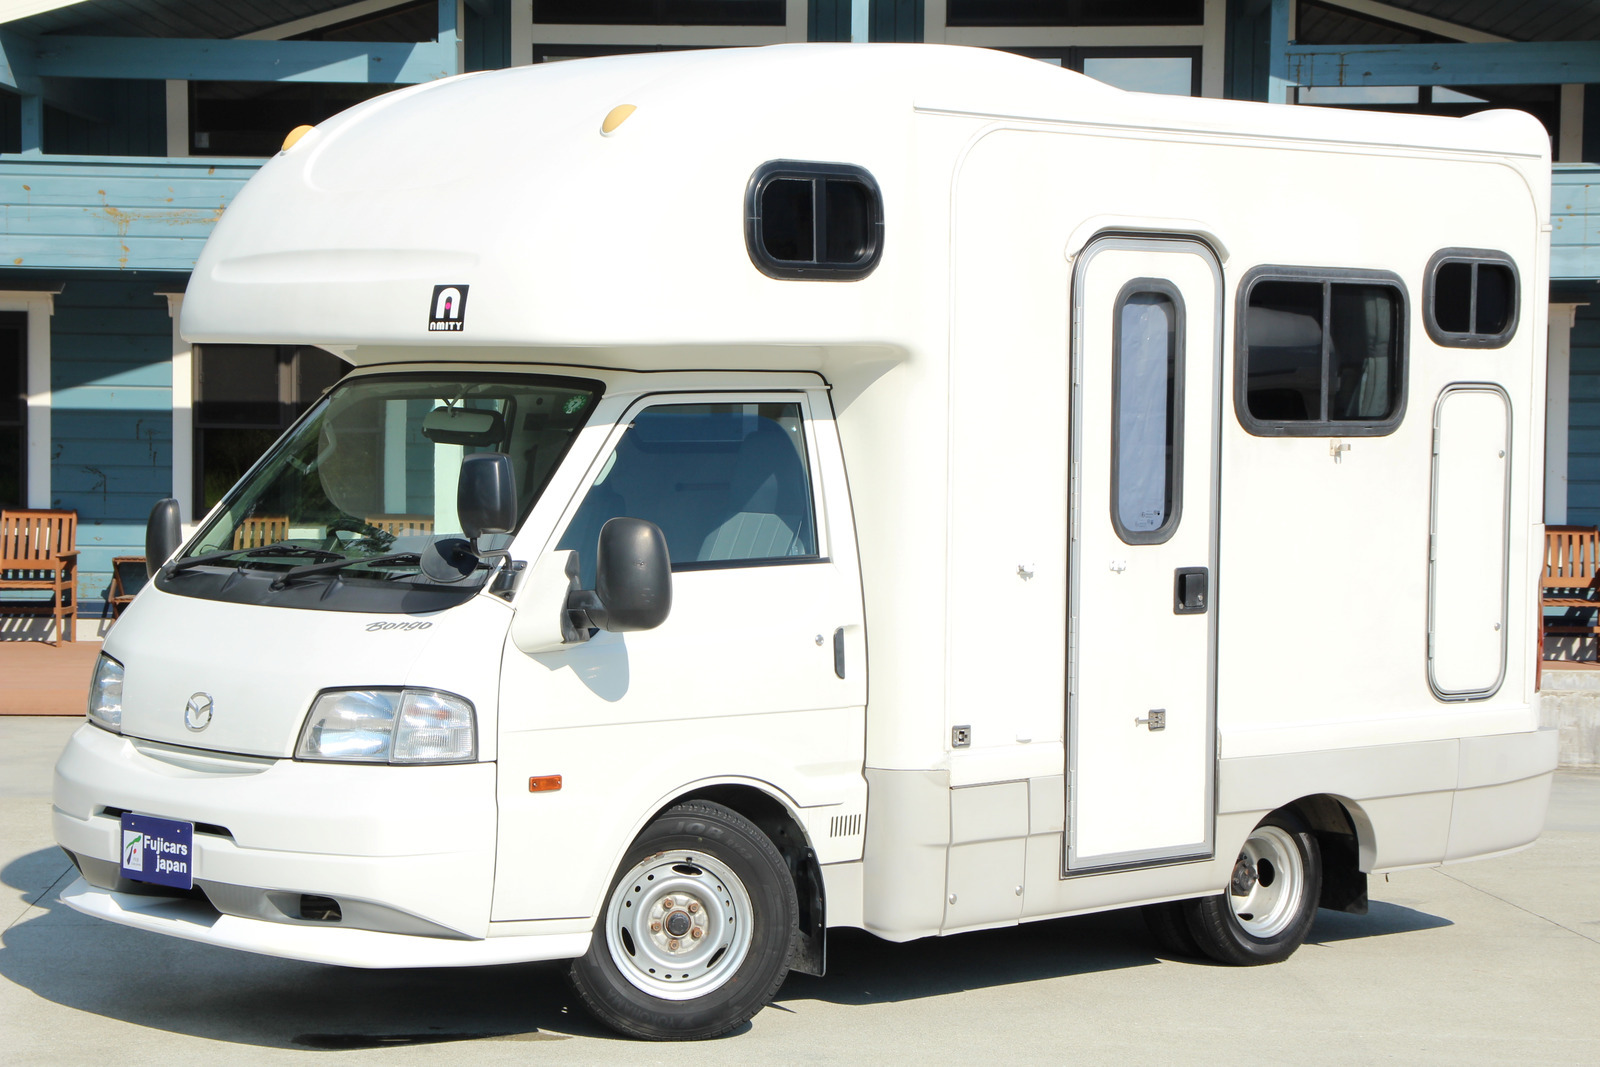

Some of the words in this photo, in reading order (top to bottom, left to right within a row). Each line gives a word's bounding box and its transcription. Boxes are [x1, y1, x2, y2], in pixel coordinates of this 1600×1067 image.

[429, 321, 463, 331] AMITY
[365, 621, 433, 632] Bongo
[144, 835, 188, 856] Fujicars
[155, 855, 187, 874] japan
